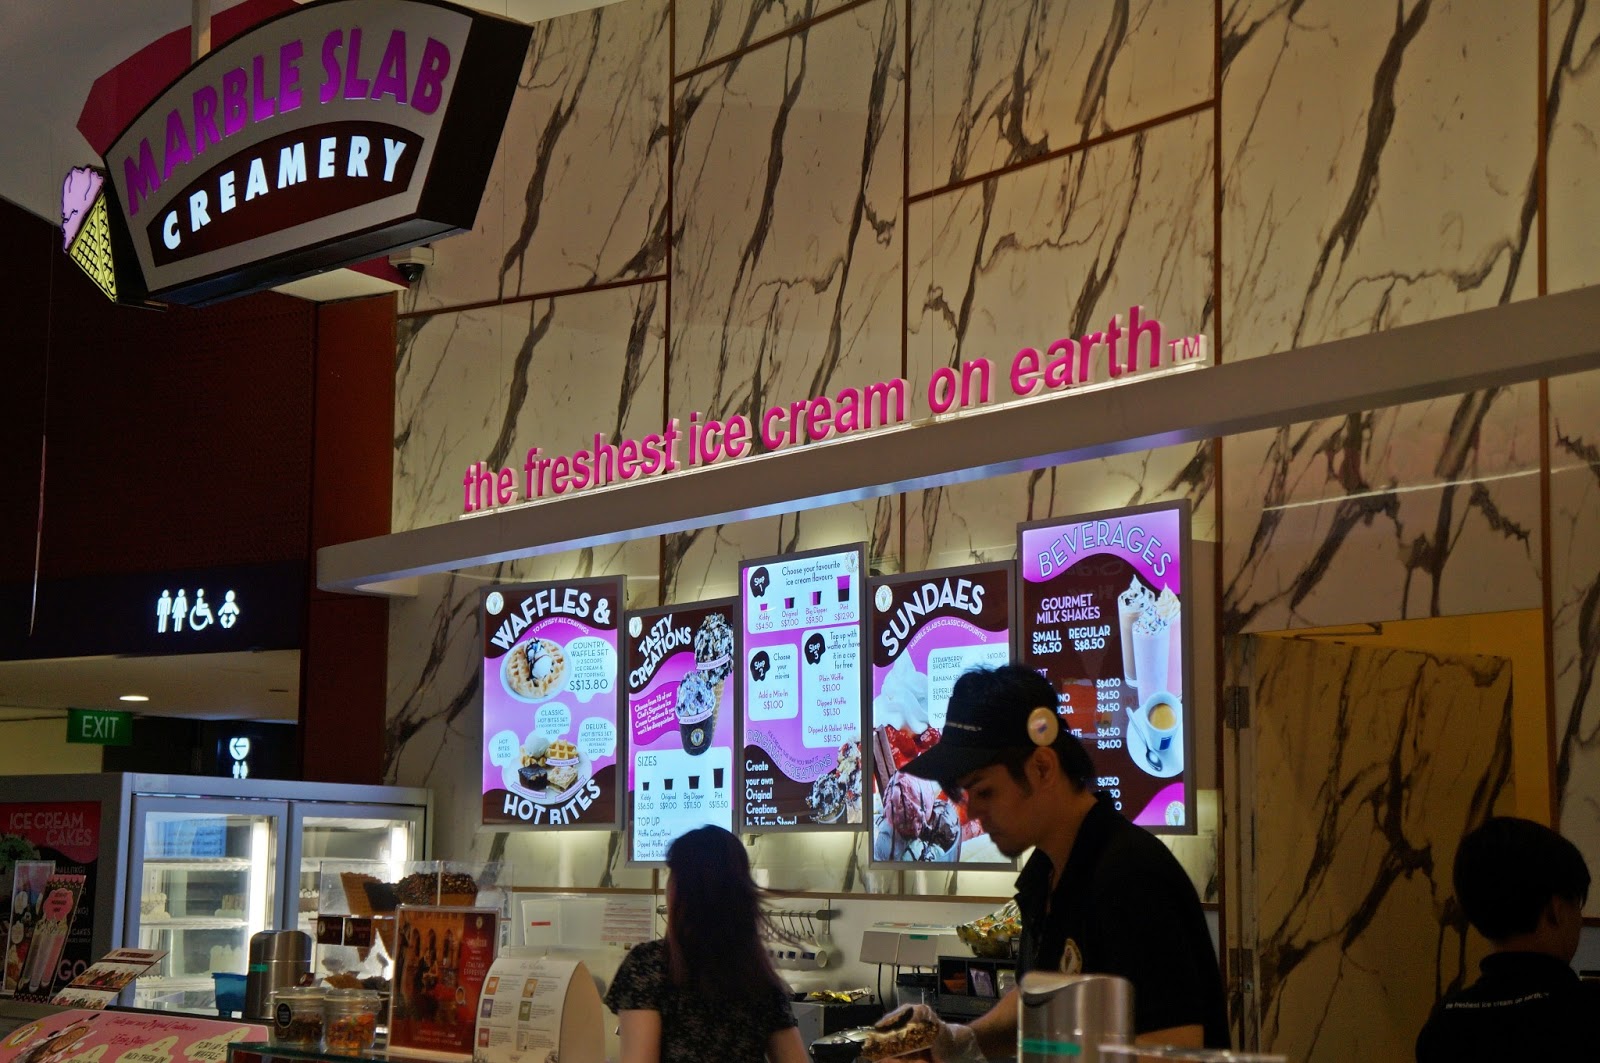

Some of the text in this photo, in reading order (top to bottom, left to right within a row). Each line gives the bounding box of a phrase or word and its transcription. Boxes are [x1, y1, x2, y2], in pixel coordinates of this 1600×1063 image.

[124, 25, 451, 217] MARBLE SLAB
[162, 135, 407, 250] CREAMERY
[463, 305, 1206, 513] the freshest ice cream on earth TM
[1038, 521, 1172, 577] BEVERAGES
[782, 560, 841, 576] Choose your favourite
[795, 576, 811, 584] cream
[812, 573, 833, 582] flavours
[1041, 593, 1093, 611] GOURMET
[490, 588, 611, 650] WAFFLES &
[881, 577, 985, 657] SUNDAES
[1036, 606, 1100, 624] MILK SHAKES
[567, 618, 590, 635] CRAVINGS
[941, 619, 960, 627] CLASSIC
[960, 621, 988, 643] FAVOURITES
[1033, 625, 1111, 643] SMALL REGULAR
[638, 614, 673, 657] TASTY
[830, 629, 857, 641] Top up with
[573, 641, 605, 649] COUNTRY
[827, 641, 841, 650] waffle
[848, 640, 860, 648] have
[1032, 638, 1105, 655] S$6.50 S$8.50
[629, 627, 692, 688] CREATIONS
[773, 653, 790, 661] Choose
[814, 651, 819, 660] 3
[932, 655, 963, 663] STRAWBERRY
[759, 668, 764, 676] 2
[843, 661, 853, 669] free
[933, 662, 960, 670] SHORTCAKE
[569, 679, 608, 691] S$13.80
[822, 683, 840, 692] S$1.00
[763, 700, 784, 710] S$1.00
[82, 715, 119, 738] EXIT
[637, 756, 657, 767] SIZES
[746, 759, 769, 772] Create
[746, 777, 774, 789] your own
[746, 787, 773, 802] Original
[503, 794, 546, 825] HOT
[746, 802, 777, 814] Creations
[9, 811, 84, 830] ICE CREAM
[638, 817, 650, 827] TOP
[46, 828, 92, 847] CAKES
[58, 960, 87, 981] GO
